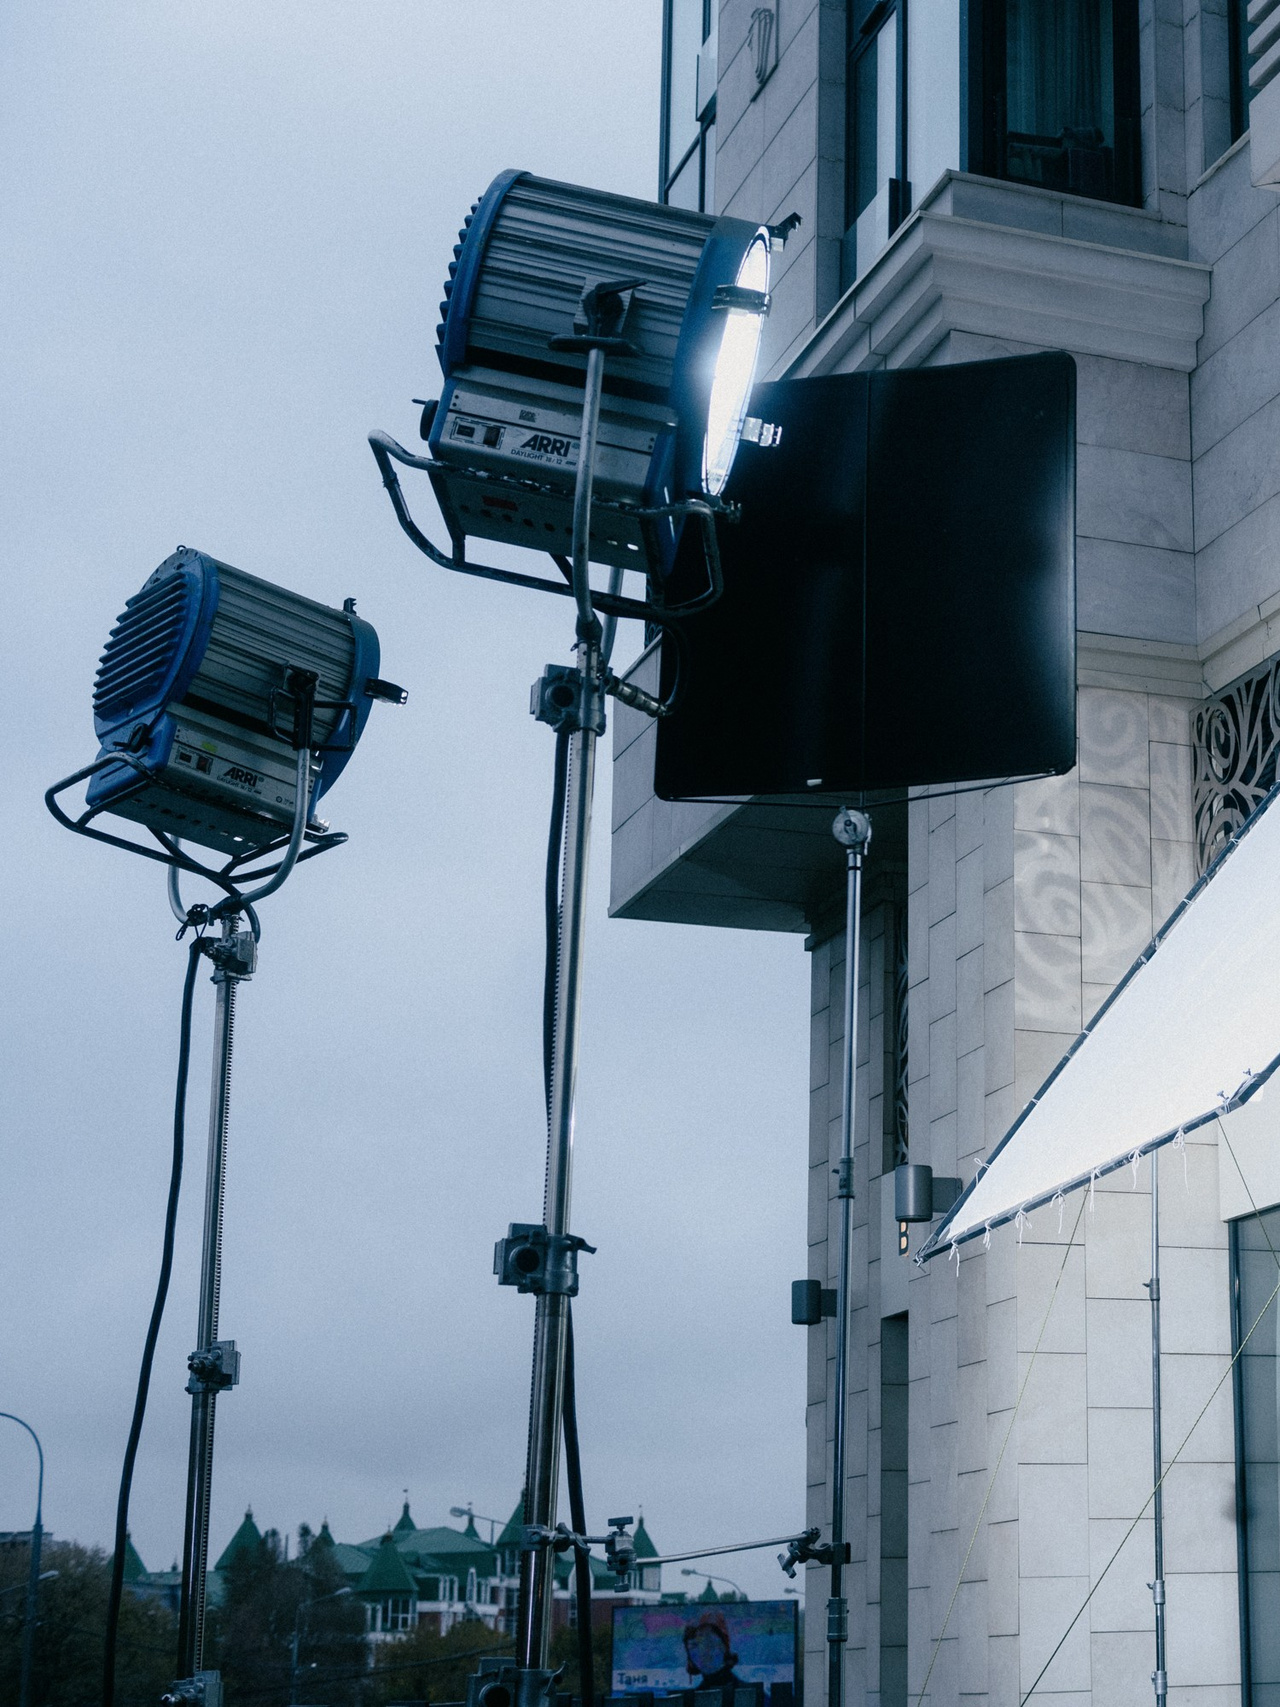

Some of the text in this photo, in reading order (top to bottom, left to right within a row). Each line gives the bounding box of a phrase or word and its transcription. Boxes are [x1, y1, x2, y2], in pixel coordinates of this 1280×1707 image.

[510, 448, 544, 461] DAYLIGHT
[520, 434, 571, 458] ARRI
[223, 766, 259, 787] ARRI
